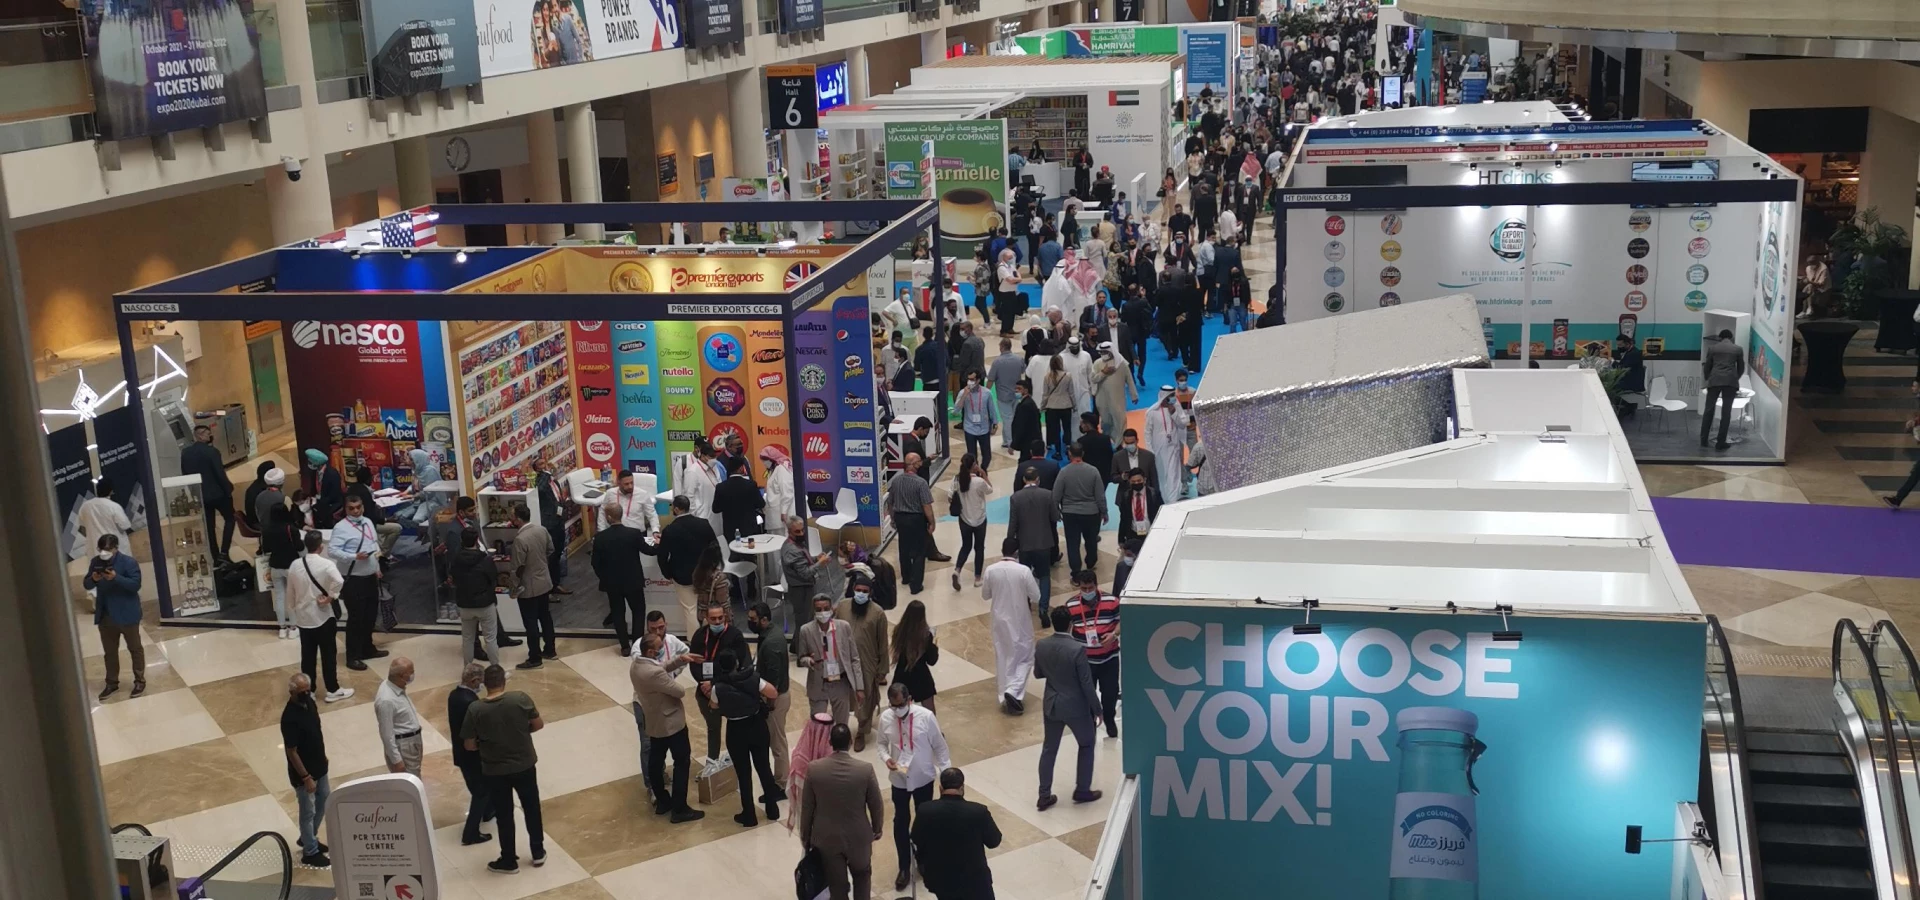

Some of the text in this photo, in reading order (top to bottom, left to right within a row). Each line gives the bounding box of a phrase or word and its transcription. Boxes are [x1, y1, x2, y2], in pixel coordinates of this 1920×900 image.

[1123, 6, 1132, 20] 7
[478, 3, 514, 62] ulfood
[605, 19, 640, 43] BRANDS
[145, 43, 168, 54] October
[169, 42, 183, 52] 2021
[188, 41, 195, 51] 31
[195, 40, 213, 49] March
[213, 38, 227, 47] 2022
[410, 33, 450, 49] BOOK YOUR
[1092, 42, 1135, 50] HAMRIYAH
[408, 47, 454, 64] TICKETS NOW
[157, 56, 218, 77] BOOK YOUR
[154, 74, 224, 97] TICKETS NOW
[781, 78, 802, 87] قاعة
[785, 88, 799, 96] Hall
[157, 95, 227, 115] expo2020dubai.com
[785, 97, 802, 127] 6
[957, 133, 999, 141] COMPANIES
[935, 166, 1000, 180] armelle
[1479, 169, 1553, 185] HTdrinks
[124, 304, 176, 312] NASCO CC6-8
[671, 305, 710, 313] PREMIER
[713, 305, 751, 313] EXPORTS
[795, 322, 827, 331] LAVAZZA
[322, 323, 405, 346] nasco
[358, 346, 406, 356] Global Export
[576, 341, 608, 353] Ribena
[662, 367, 694, 376] nutella
[844, 367, 865, 380] Pringles
[622, 390, 652, 404] belVita
[585, 414, 612, 424] Heinz
[624, 417, 656, 430] Kellogg's
[386, 423, 417, 441] Alpen
[668, 430, 700, 440] HERSHEY'S
[757, 425, 789, 436] Kinder
[627, 436, 656, 451] Alpen
[806, 436, 828, 456] illy
[100, 449, 117, 459] Working
[806, 471, 831, 480] Kenco
[1146, 621, 1520, 699] CHOOSE
[1144, 688, 1391, 762] YOUR
[1149, 756, 1332, 827] MIX!
[355, 805, 398, 829] Gulfood
[1416, 810, 1459, 821] NO COLORING
[1408, 833, 1438, 849] Mix
